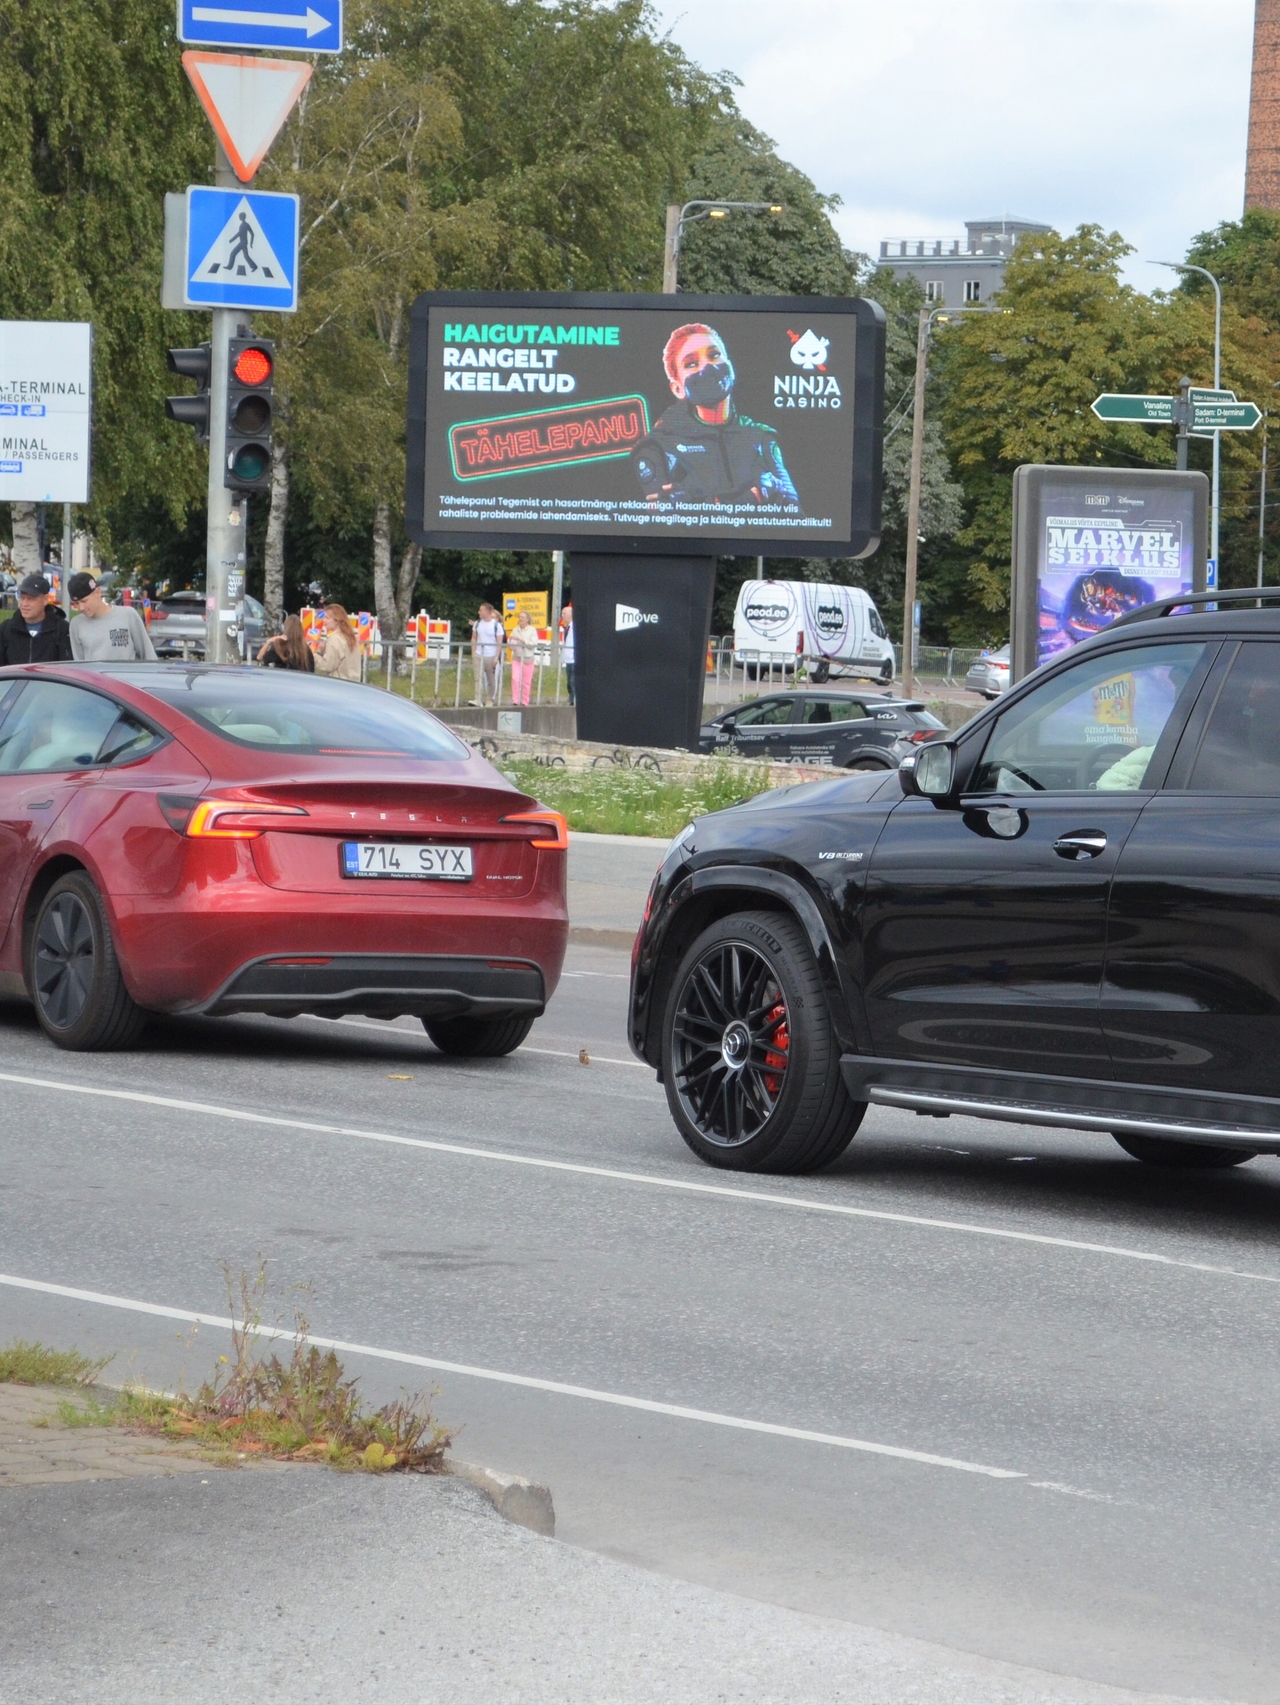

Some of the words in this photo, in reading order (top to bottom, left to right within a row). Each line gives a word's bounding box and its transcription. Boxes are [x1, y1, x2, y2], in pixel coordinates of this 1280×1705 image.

[444, 324, 620, 345] HAIGUTAMINE
[443, 347, 558, 368] RANGELT
[444, 371, 576, 393] KEELATUD
[774, 375, 841, 396] NINJA
[774, 396, 841, 409] CASINO
[1144, 402, 1172, 410] Vanalinn
[0, 438, 48, 450] MINAL
[460, 413, 639, 464] TÄHELEPANU
[12, 451, 78, 461] PASSENGERS
[439, 496, 496, 507] Tähelepanu!
[498, 497, 540, 508] Tegemist
[541, 500, 554, 508] on
[554, 498, 618, 512] hasartmängu
[619, 500, 674, 512] reklaamiga.
[675, 501, 734, 514] Hasartmäng
[735, 502, 756, 514] pole
[757, 503, 782, 513] sobiv
[784, 504, 798, 513] viis
[439, 508, 478, 518] rahaliste
[480, 509, 538, 521] probleemide
[540, 510, 612, 522] lahendamiseks.
[613, 513, 650, 525] Tutvuge
[652, 514, 698, 526] reeglitega
[699, 515, 710, 526] ja
[711, 515, 746, 527] käituge
[747, 516, 832, 528] vastutustundlikult!
[1050, 518, 1077, 526] VÕIMALUS
[1078, 519, 1093, 527] VÕITA
[1049, 528, 1180, 551] MARVEL
[1049, 548, 1180, 568] SEIKLUS
[1206, 562, 1213, 584] P
[622, 612, 659, 624] move
[747, 607, 787, 618] peod.ee
[818, 610, 843, 624] peod.ee
[1106, 725, 1139, 734] kamba
[1086, 734, 1137, 745] kangelane!
[350, 811, 468, 823] TESLA
[346, 861, 358, 869] EST
[363, 846, 400, 870] 714
[419, 848, 466, 872] SYX
